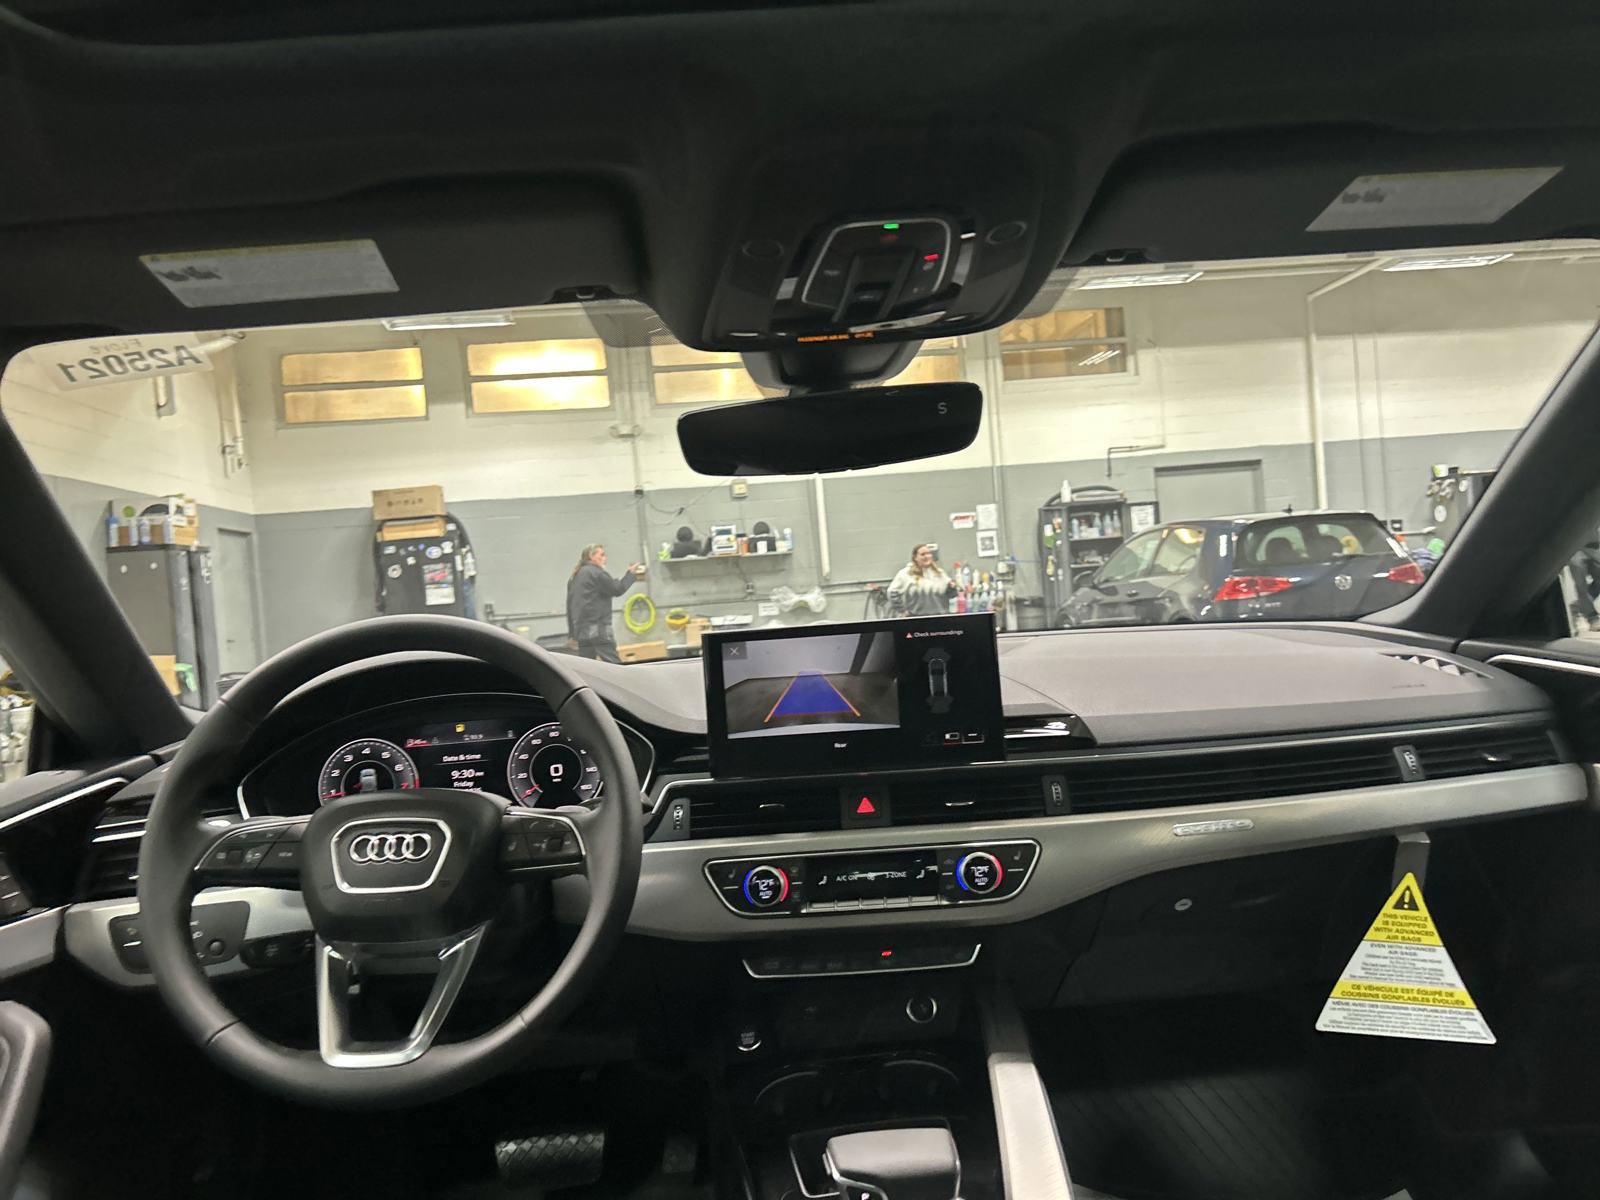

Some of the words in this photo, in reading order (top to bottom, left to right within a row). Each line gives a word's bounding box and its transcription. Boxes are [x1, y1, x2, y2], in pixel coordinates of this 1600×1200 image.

[929, 629, 964, 637] surroundings
[343, 754, 354, 762] 3
[381, 751, 391, 759] 5
[331, 769, 341, 777] 2
[451, 769, 475, 780] 9:30
[550, 764, 563, 777] 0
[1400, 914, 1428, 922] VEHICLE
[1391, 921, 1427, 929] EQUIPPED
[1395, 928, 1435, 937] ADVANCED
[1363, 983, 1398, 994] VÉHICULE
[1416, 986, 1443, 997] ÉQUIPÉ
[1341, 991, 1379, 1000] COUSSINS
[1381, 993, 1431, 1003] GONFLABLES
[1432, 996, 1466, 1006] ÉVOLUÉS
